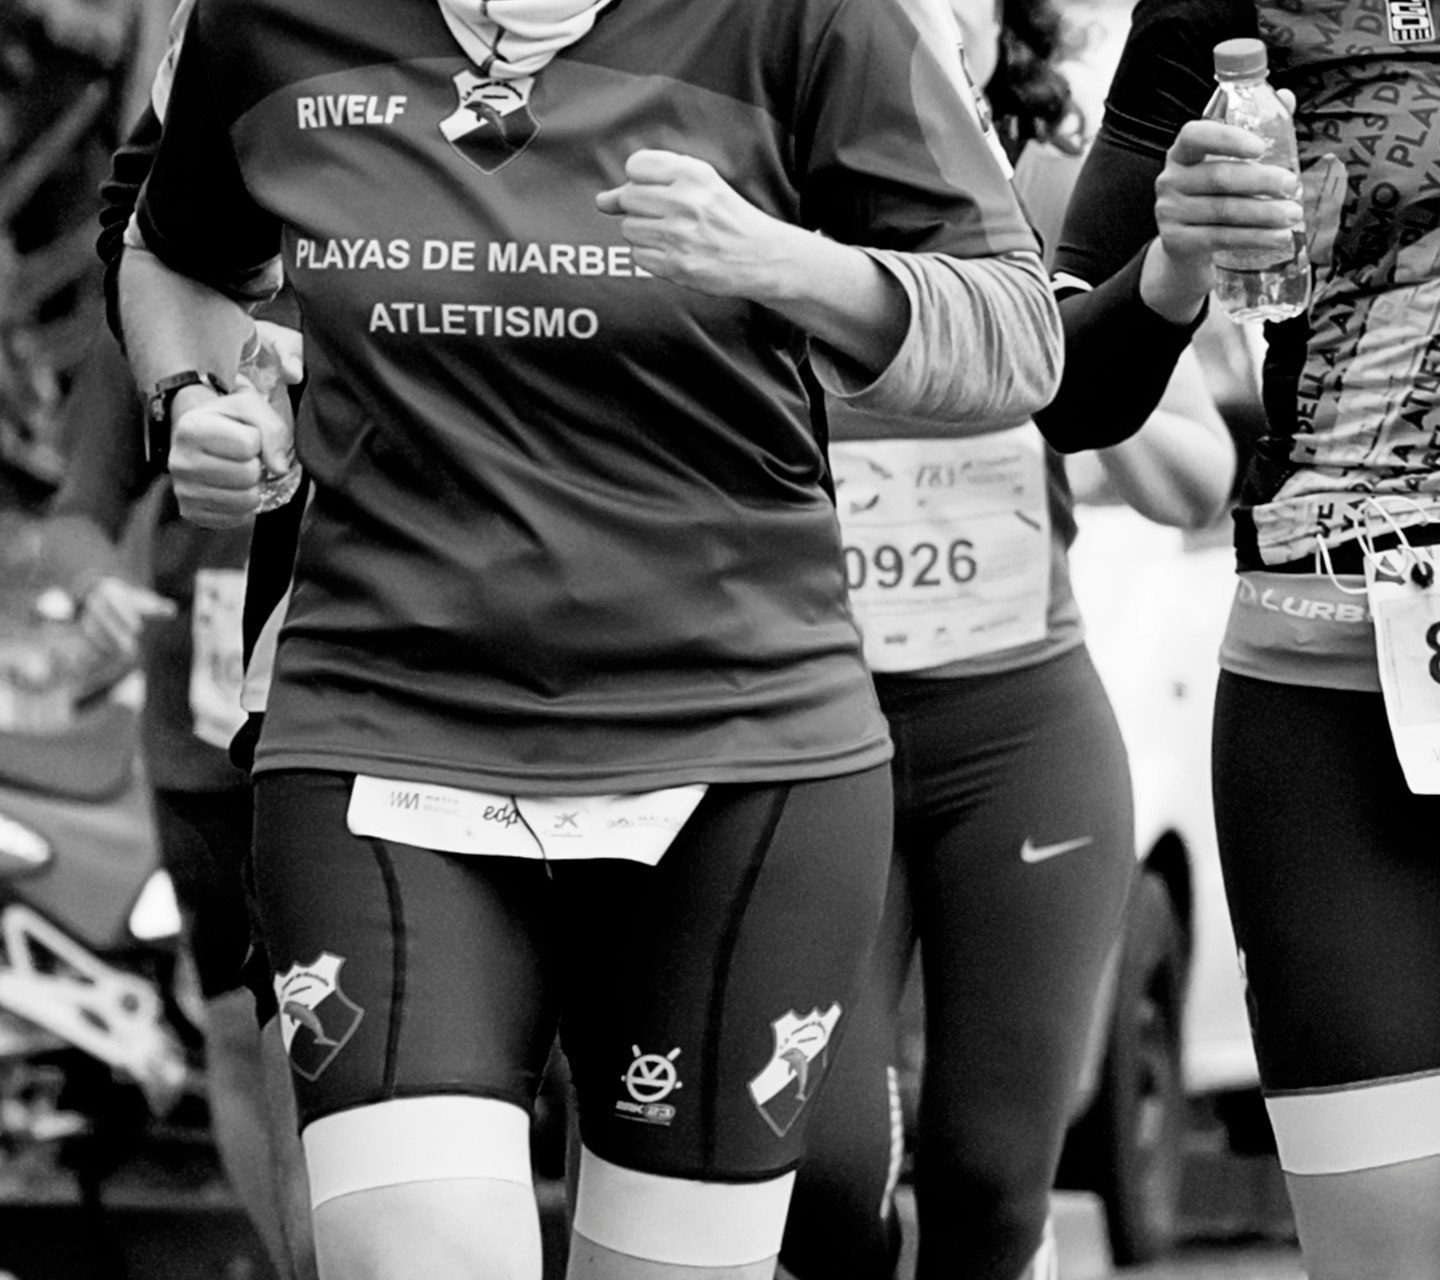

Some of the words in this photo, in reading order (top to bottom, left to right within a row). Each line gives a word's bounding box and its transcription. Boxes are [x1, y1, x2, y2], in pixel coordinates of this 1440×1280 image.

[297, 95, 408, 129] RIVELF
[296, 239, 411, 270] PLAYAS
[423, 240, 476, 271] DE
[488, 242, 653, 278] MARBE
[369, 303, 600, 339] ATLETISMO
